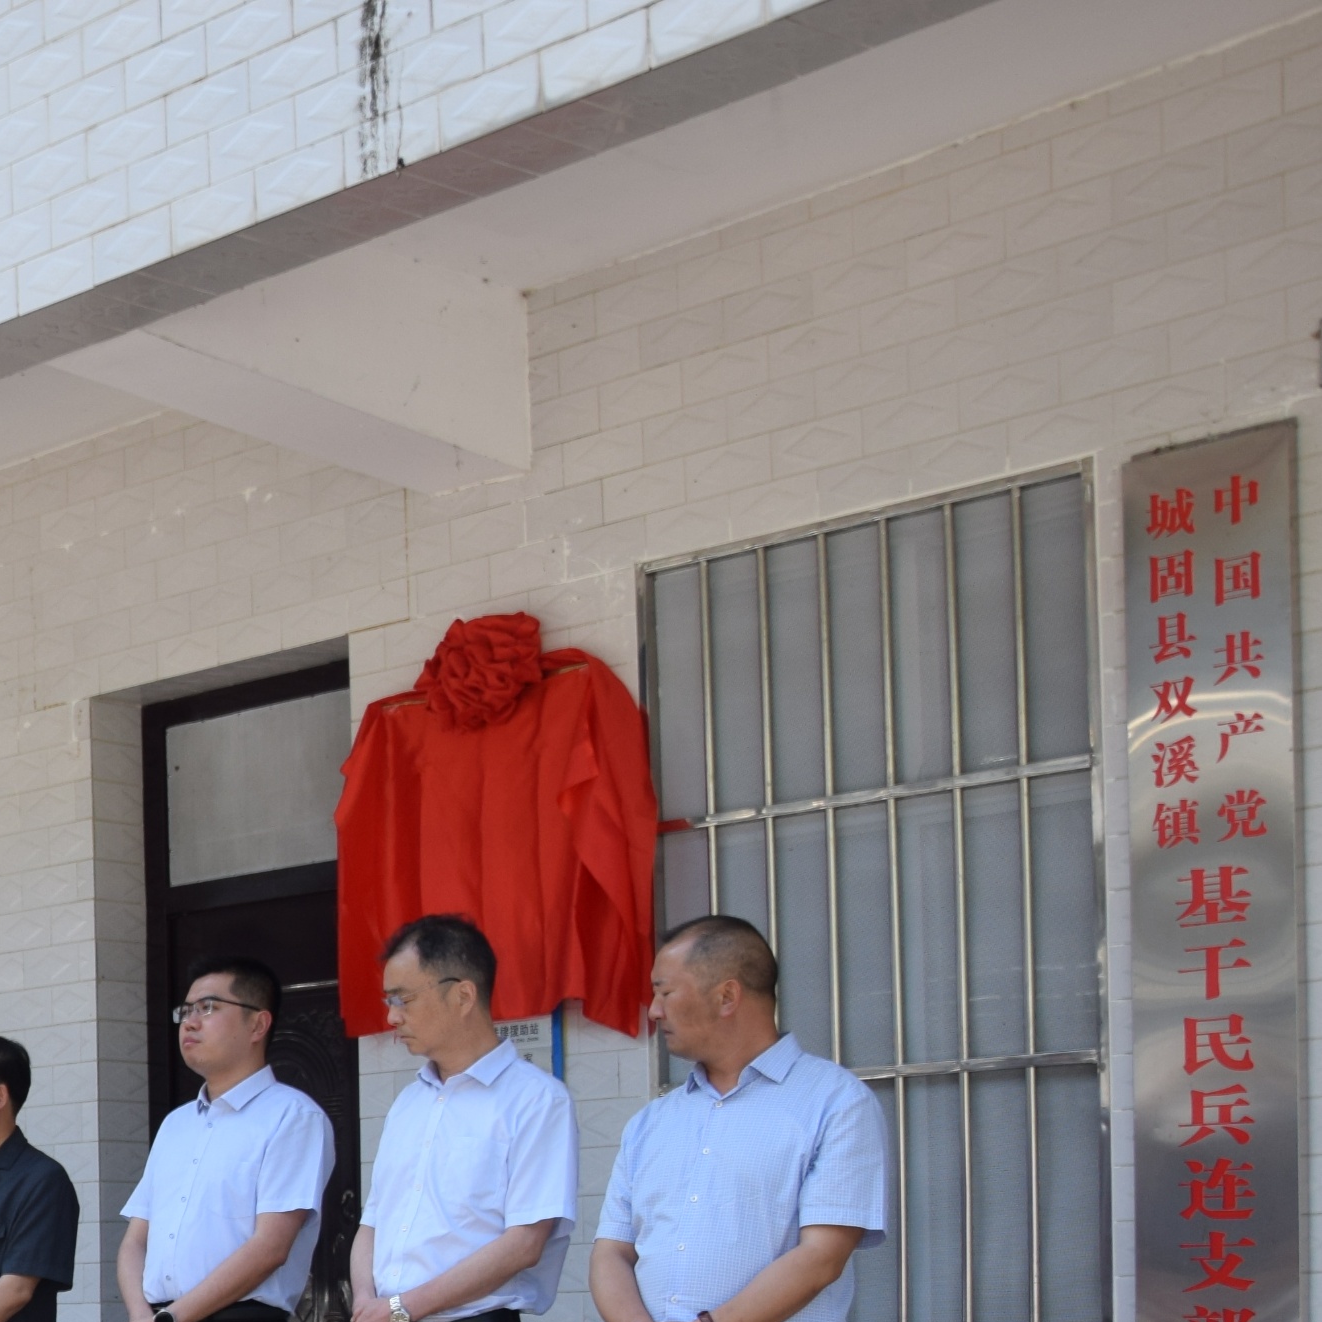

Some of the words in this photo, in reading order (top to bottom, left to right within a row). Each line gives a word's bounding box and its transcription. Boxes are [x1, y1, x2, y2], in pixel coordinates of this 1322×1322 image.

[1146, 487, 1200, 851] 城固县双溪镇
[1212, 473, 1268, 844] 中国共产党
[494, 1022, 539, 1037] 律援助站
